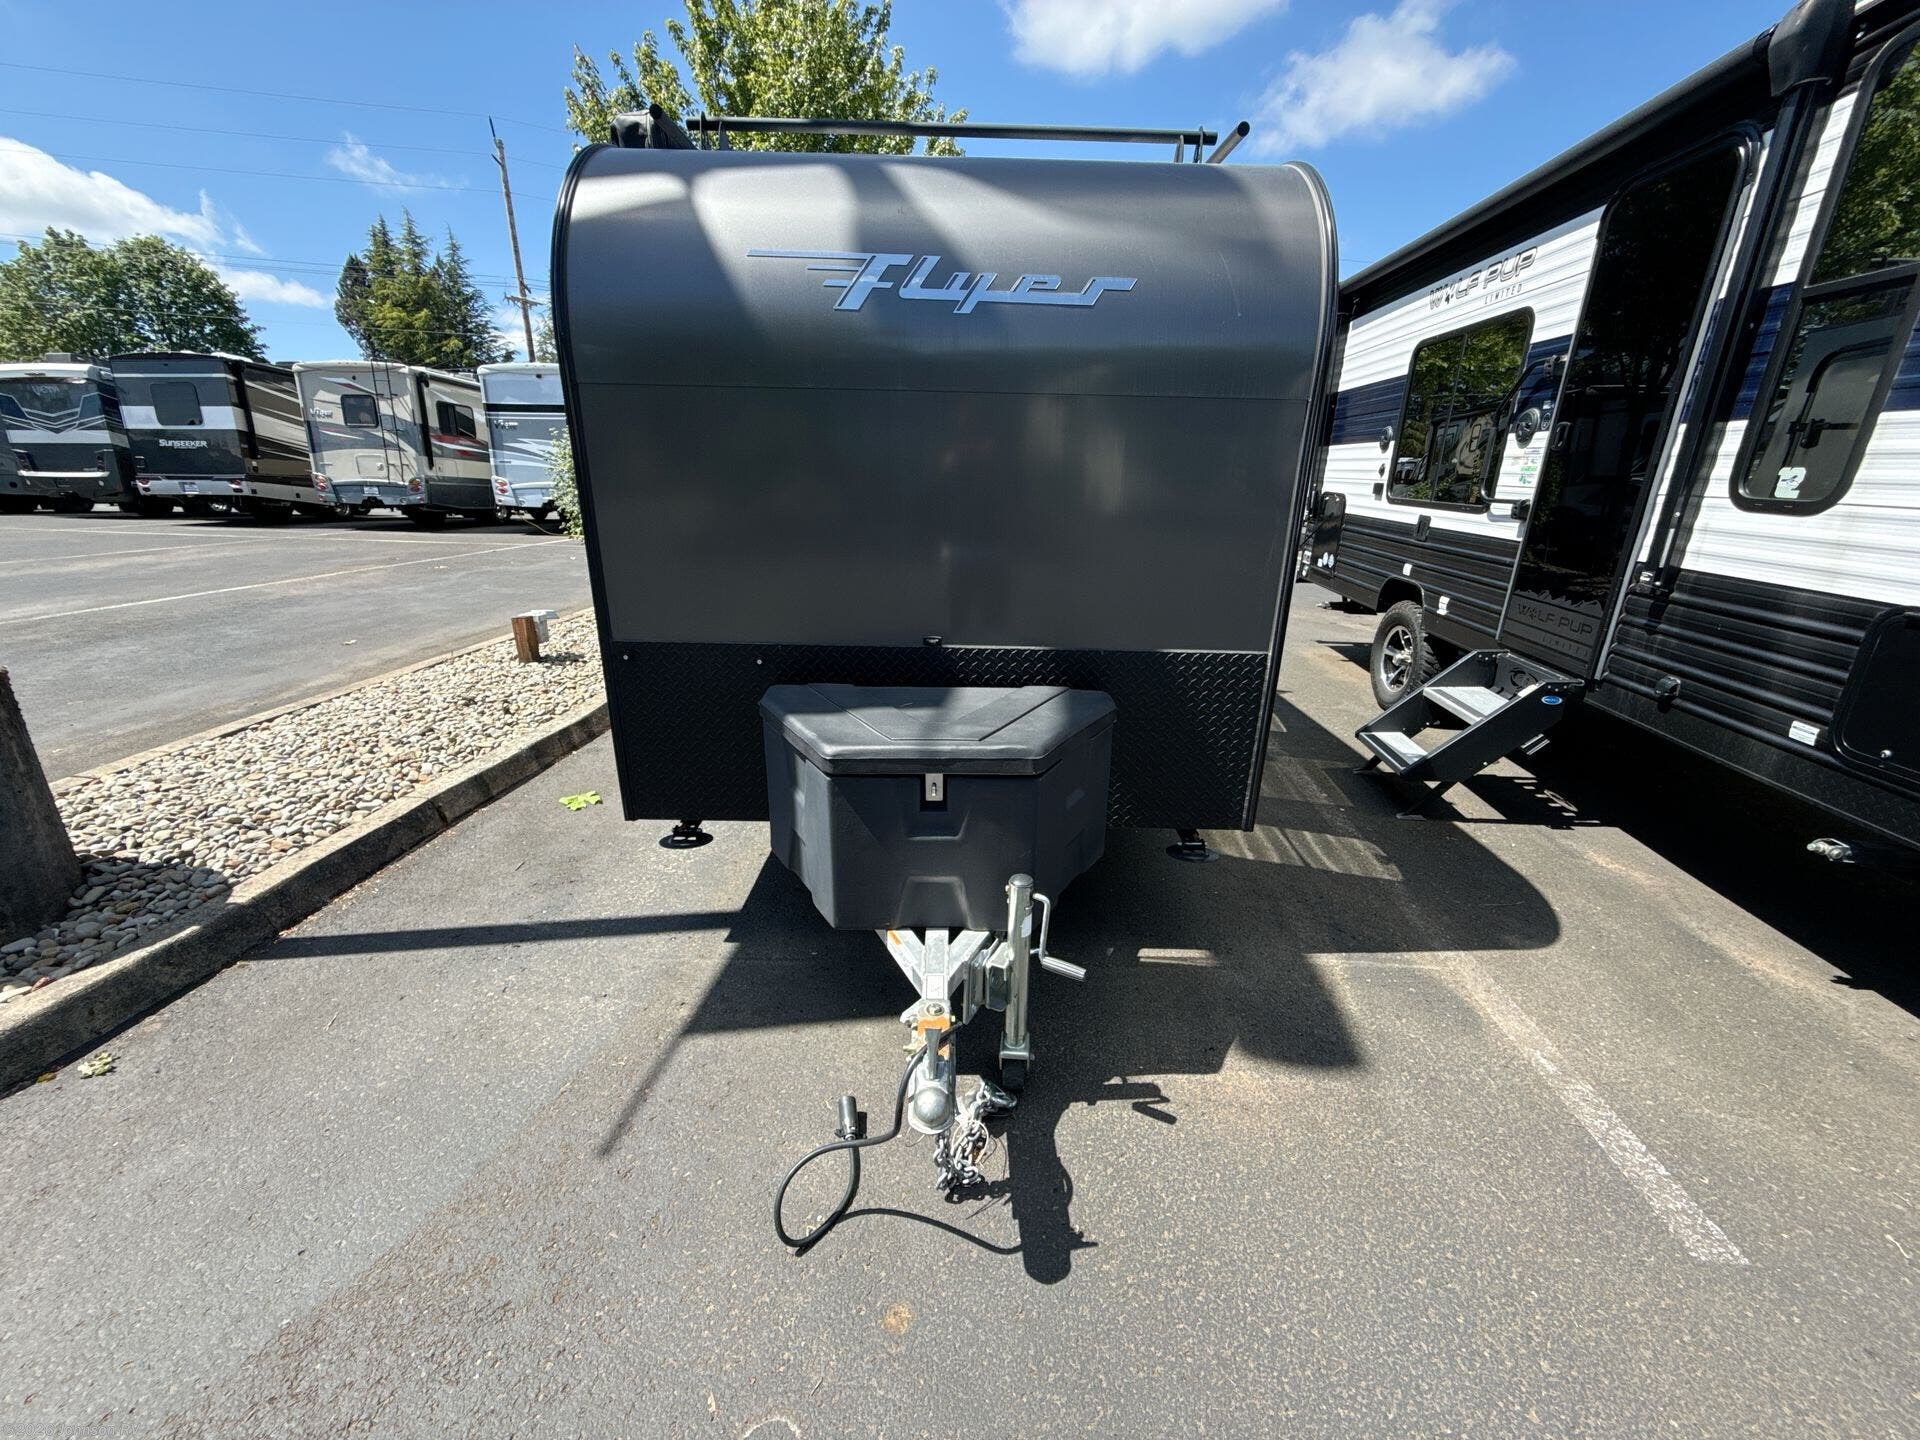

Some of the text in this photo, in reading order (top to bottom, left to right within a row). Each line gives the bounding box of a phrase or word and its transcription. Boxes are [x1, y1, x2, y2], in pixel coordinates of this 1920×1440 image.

[746, 248, 1138, 314] Flyer
[1483, 245, 1538, 290] PUP
[1484, 283, 1523, 305] LIMITED
[1558, 616, 1594, 635] PUP
